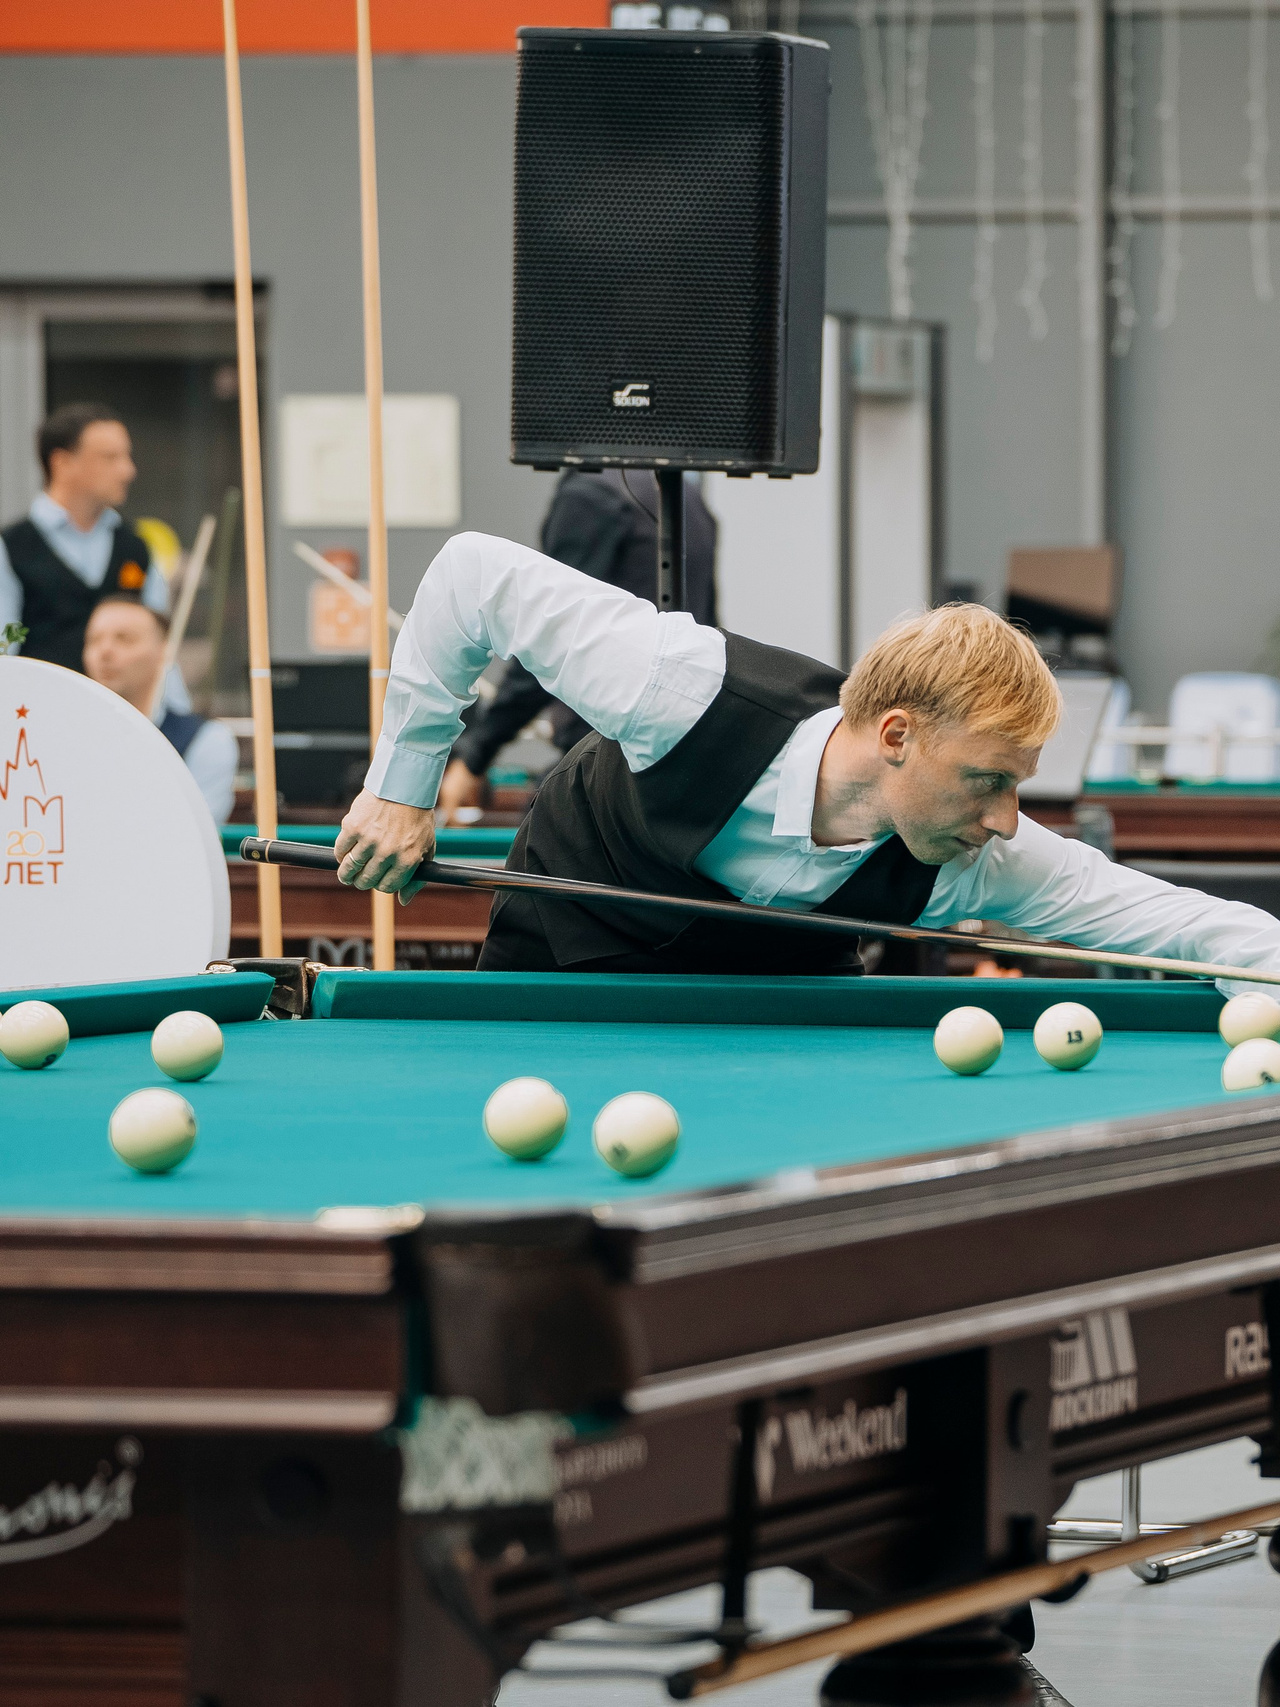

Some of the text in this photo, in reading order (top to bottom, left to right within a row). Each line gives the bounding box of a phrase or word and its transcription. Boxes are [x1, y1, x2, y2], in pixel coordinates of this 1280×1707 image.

[613, 396, 651, 407] SOLTON
[4, 861, 65, 885] ЛЕТ
[1067, 1029, 1084, 1044] 13
[785, 1387, 908, 1472] Weekend
